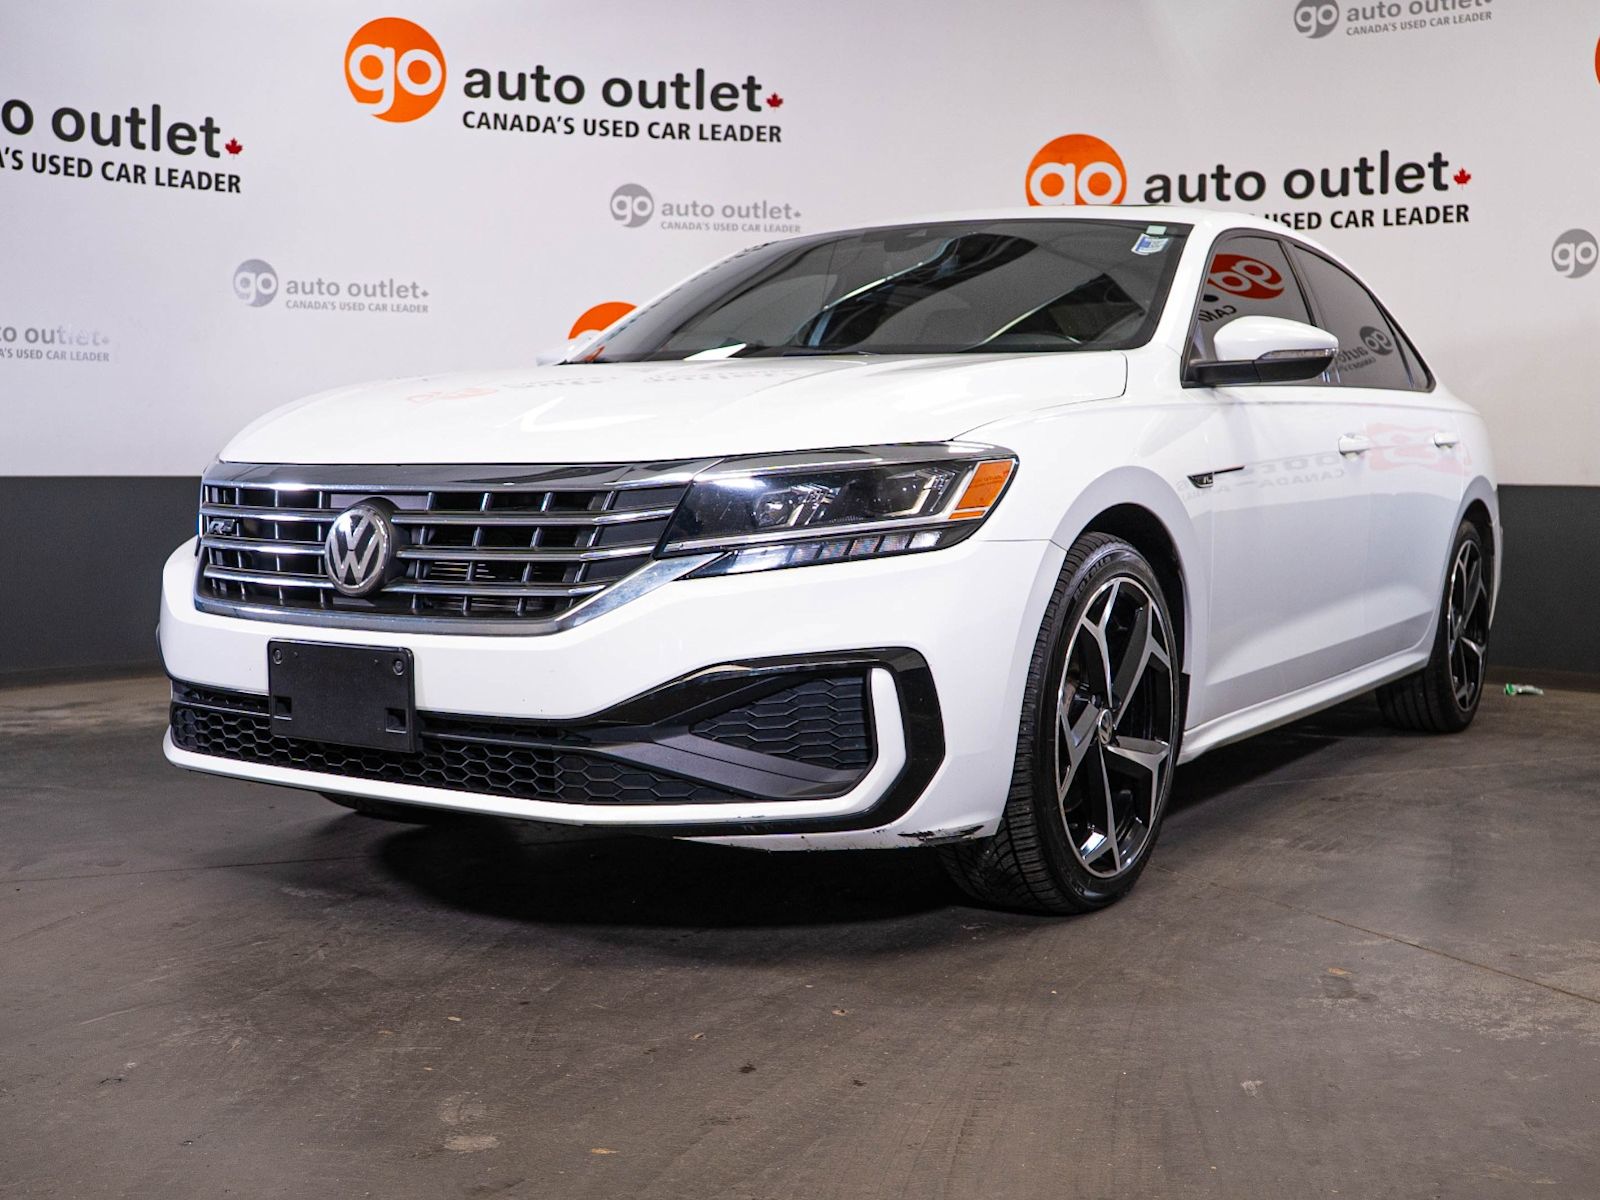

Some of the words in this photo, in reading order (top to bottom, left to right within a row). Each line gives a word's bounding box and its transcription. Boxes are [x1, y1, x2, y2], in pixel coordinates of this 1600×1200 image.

[1295, 4, 1338, 37] go
[1346, 2, 1402, 22] auto
[1346, 23, 1398, 36] CANADA'S
[1400, 19, 1427, 30] USED
[1430, 16, 1450, 27] CAR
[1453, 11, 1492, 24] LEADER
[349, 44, 442, 115] go
[463, 65, 585, 105] auto
[602, 68, 762, 112] outlet
[52, 104, 221, 158] outlet
[462, 111, 575, 135] CANADA'S
[583, 118, 639, 138] USED
[648, 122, 690, 140] CAR
[699, 123, 782, 143] LEADER
[32, 152, 93, 178] USED
[101, 161, 147, 184] CAR
[155, 167, 241, 193] LEADER
[1144, 164, 1266, 204] auto
[1283, 150, 1449, 199] outlet
[611, 194, 653, 225] go
[661, 200, 715, 218] auto
[721, 200, 792, 220] outlet
[1330, 209, 1374, 229] CAR
[1383, 204, 1470, 226] LEADER
[661, 221, 710, 231] CANADA'S
[713, 222, 739, 232] USED
[741, 223, 761, 233] CAR
[763, 224, 801, 233] LEADER
[1553, 241, 1597, 277] go
[235, 271, 277, 305] go
[286, 278, 340, 296] auto
[347, 278, 420, 299] outlet
[286, 300, 336, 310] CANADA'S
[339, 301, 365, 312] USED
[368, 303, 388, 312] CAR
[391, 304, 429, 314] LEADER
[0, 326, 17, 343] o
[16, 348, 43, 360] USED
[46, 350, 67, 361] CAR
[70, 351, 110, 362] LEADER
